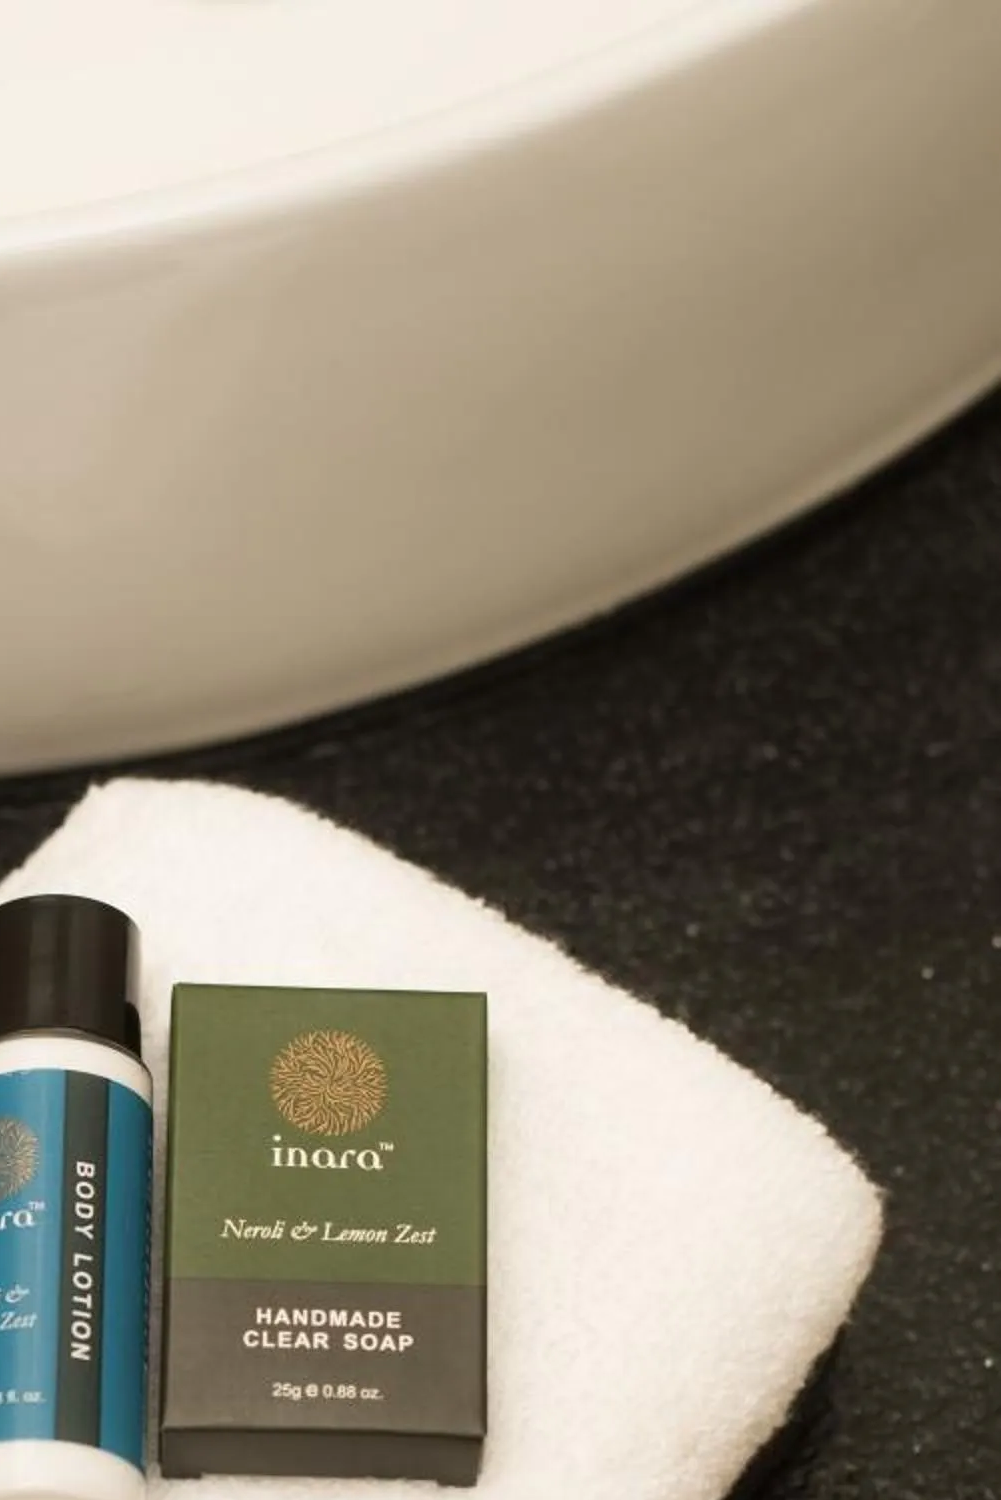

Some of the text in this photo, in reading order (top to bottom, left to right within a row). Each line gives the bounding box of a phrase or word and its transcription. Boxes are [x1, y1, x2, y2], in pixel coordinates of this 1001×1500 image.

[220, 1218, 438, 1245] Neroli & Lemon Zest
[70, 1160, 96, 1361] BODY LOTION
[4, 1283, 30, 1304] &
[255, 1307, 403, 1329] HANDMADE
[242, 1330, 415, 1352] CLEAR SOAP
[271, 1382, 302, 1401] 25g
[322, 1384, 357, 1400] 0.88
